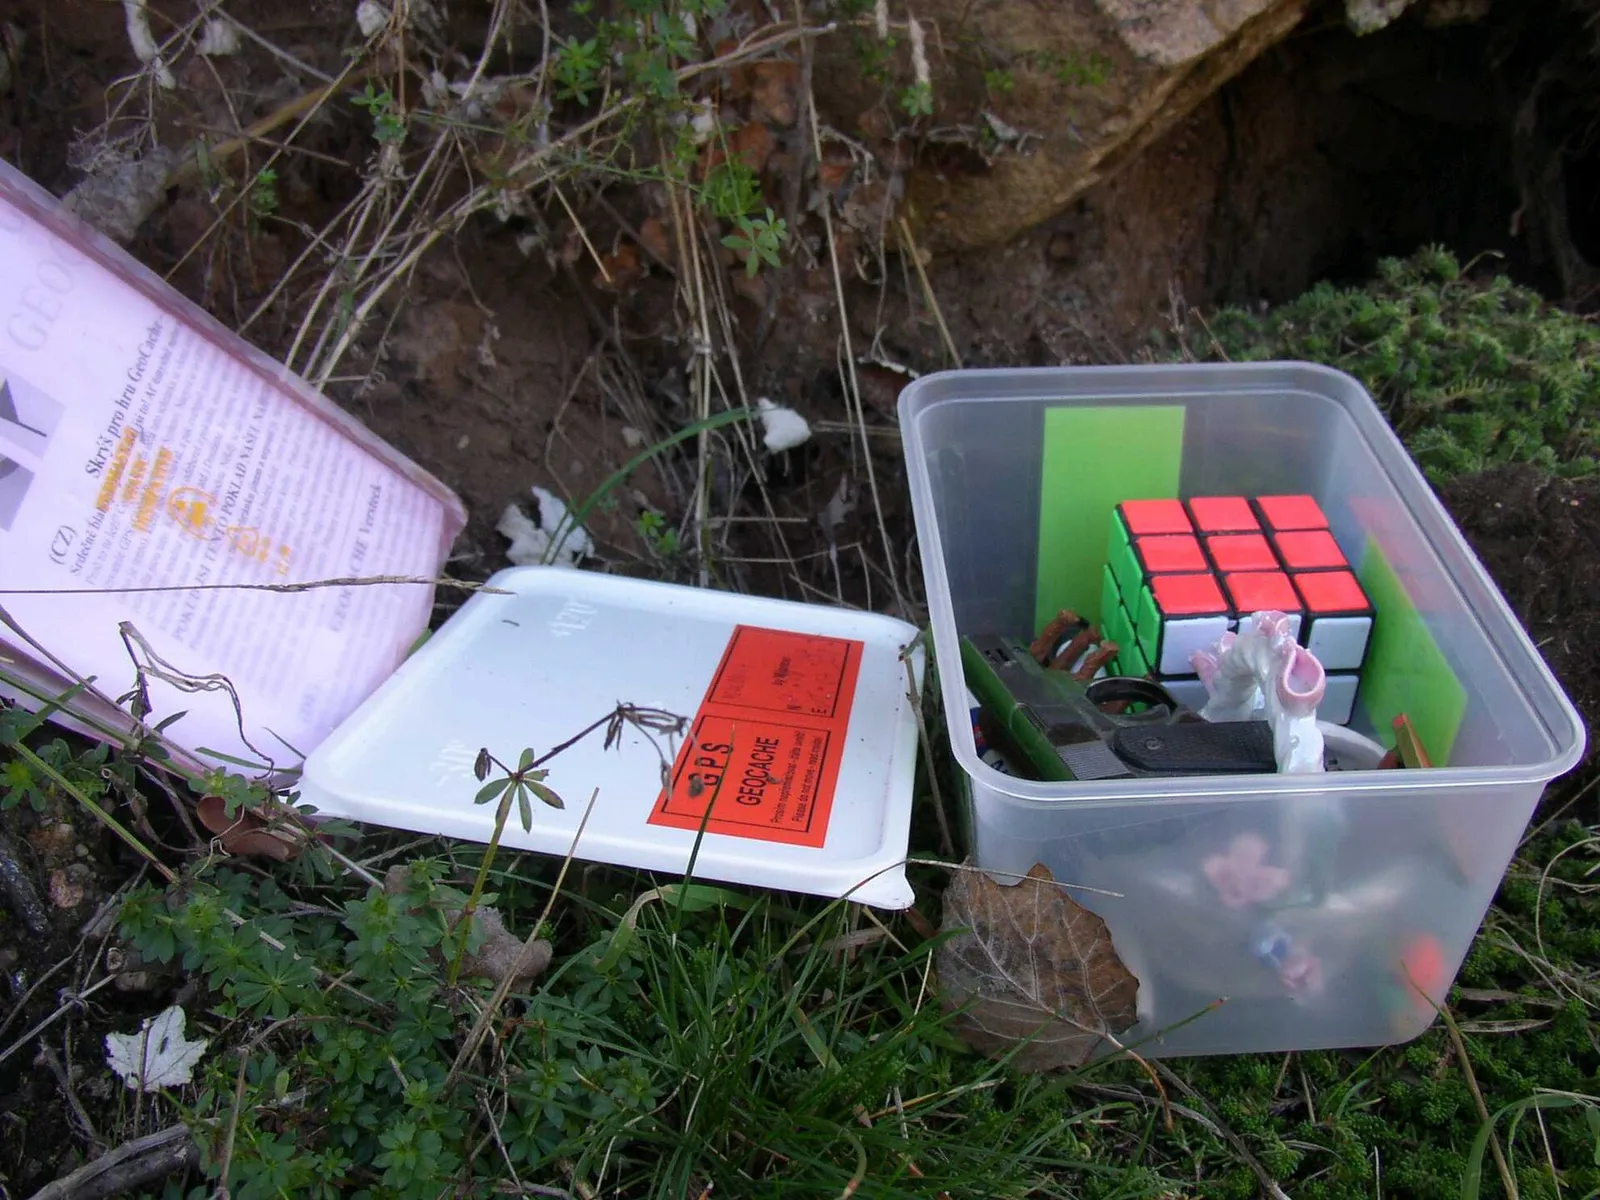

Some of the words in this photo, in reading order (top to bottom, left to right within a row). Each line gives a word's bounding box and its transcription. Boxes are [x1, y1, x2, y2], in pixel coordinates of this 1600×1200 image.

[125, 319, 164, 383] GeoCache
[114, 383, 136, 410] hru
[106, 409, 124, 438] pro
[84, 432, 114, 479] Skrýš
[733, 735, 779, 806] GEOCACHE
[796, 793, 808, 802] do
[799, 782, 811, 793] not
[791, 802, 807, 822] Please
